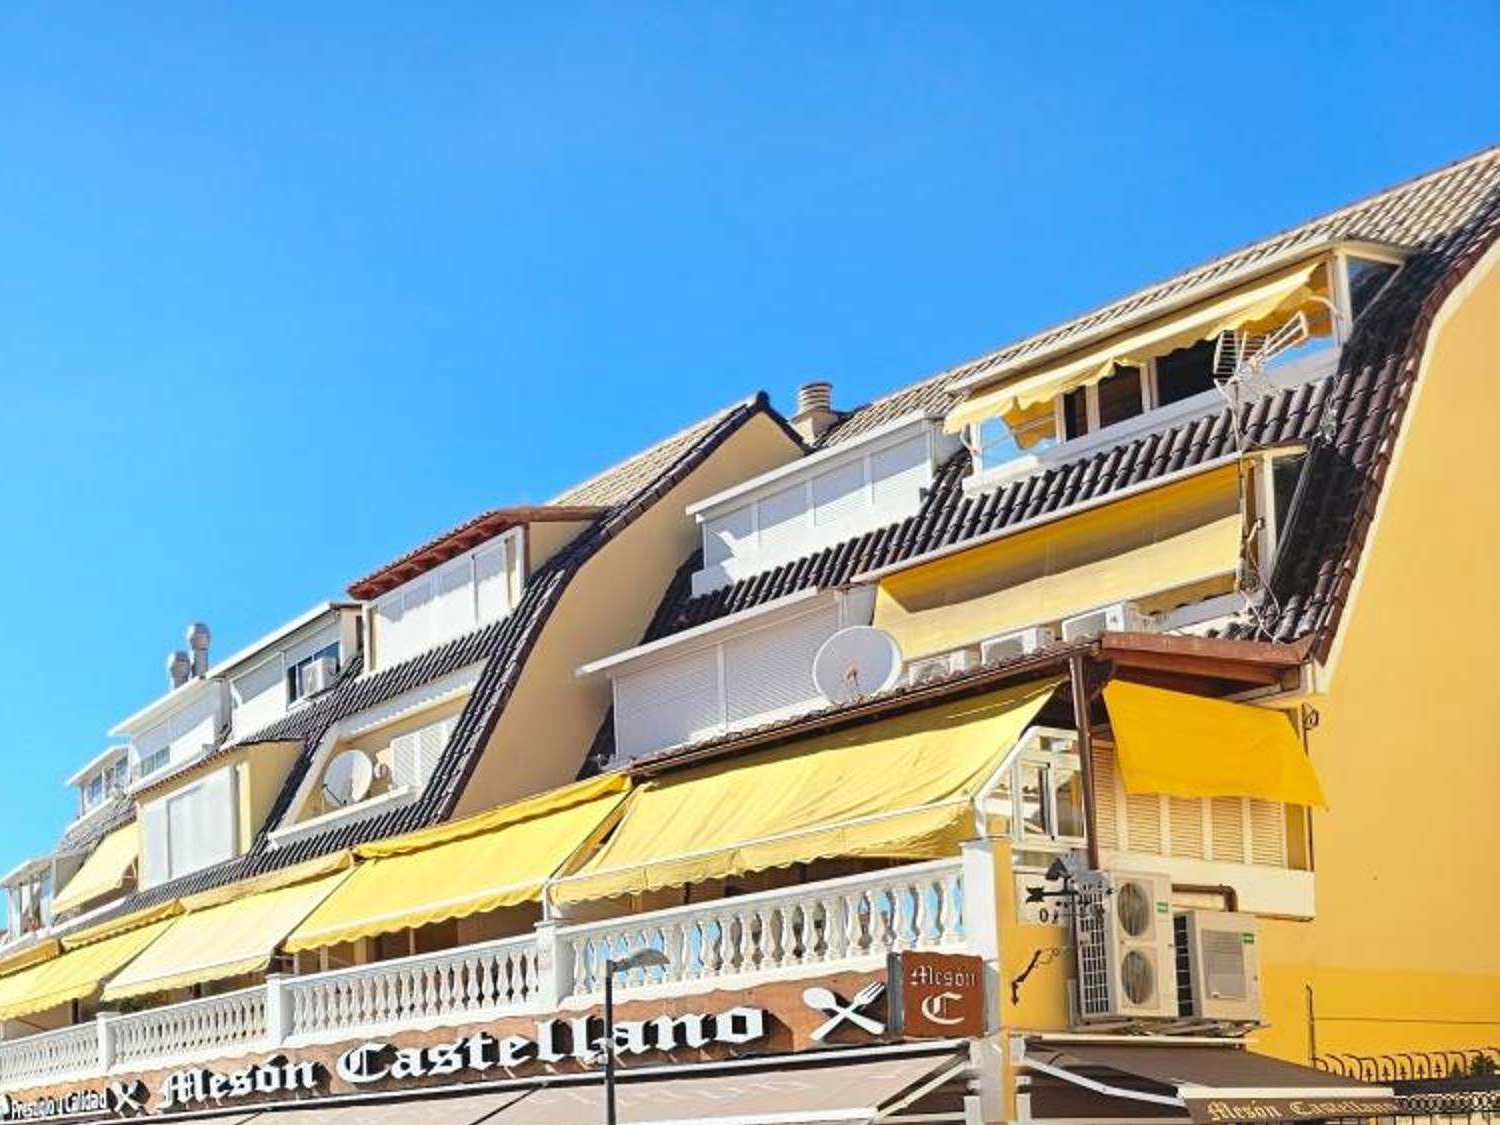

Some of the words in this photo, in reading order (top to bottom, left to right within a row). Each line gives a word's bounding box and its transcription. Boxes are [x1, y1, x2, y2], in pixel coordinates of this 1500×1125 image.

[921, 991, 965, 1025] C
[159, 1053, 320, 1109] Mesón
[338, 1007, 766, 1084] Castellano
[1207, 1100, 1283, 1120] Mesón
